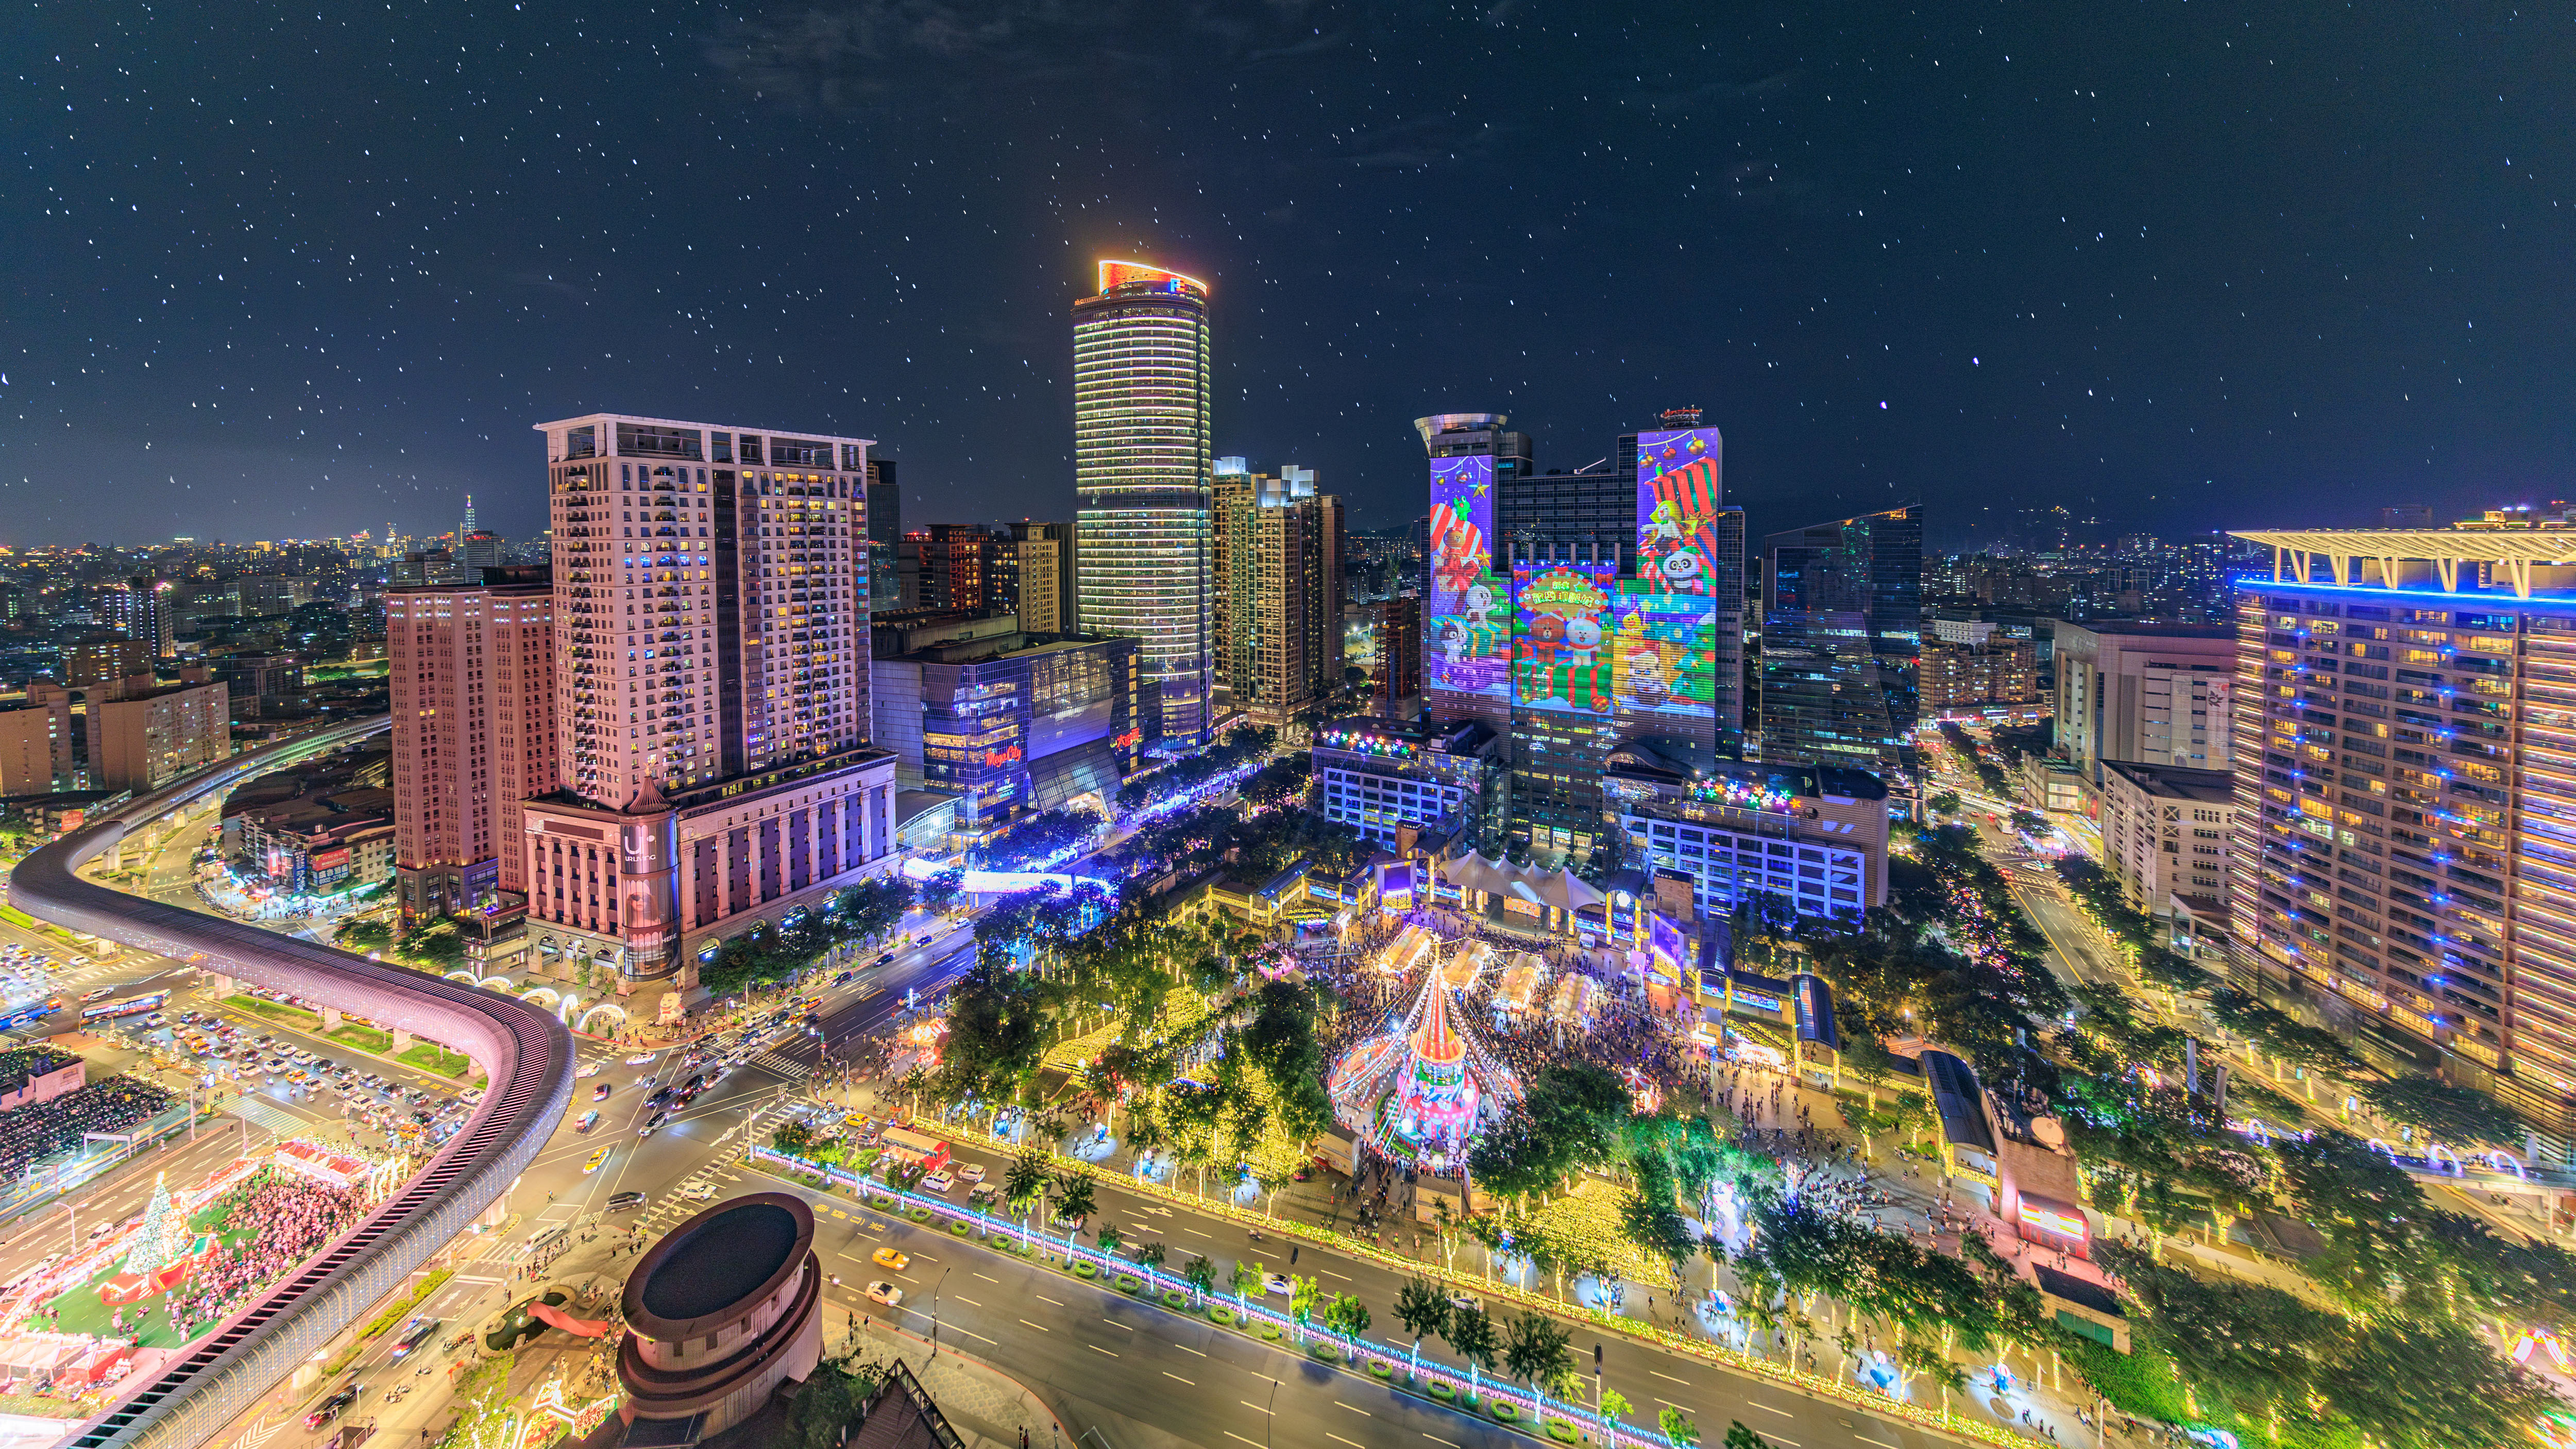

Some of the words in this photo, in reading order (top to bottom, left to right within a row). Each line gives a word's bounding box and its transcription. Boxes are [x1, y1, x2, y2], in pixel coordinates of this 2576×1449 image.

[1007, 745, 1021, 762] City
[1000, 790, 1014, 799] IMAX
[662, 933, 677, 943] HERE
[578, 1211, 602, 1225] 07-22
[814, 1203, 886, 1232] 禁行機車
